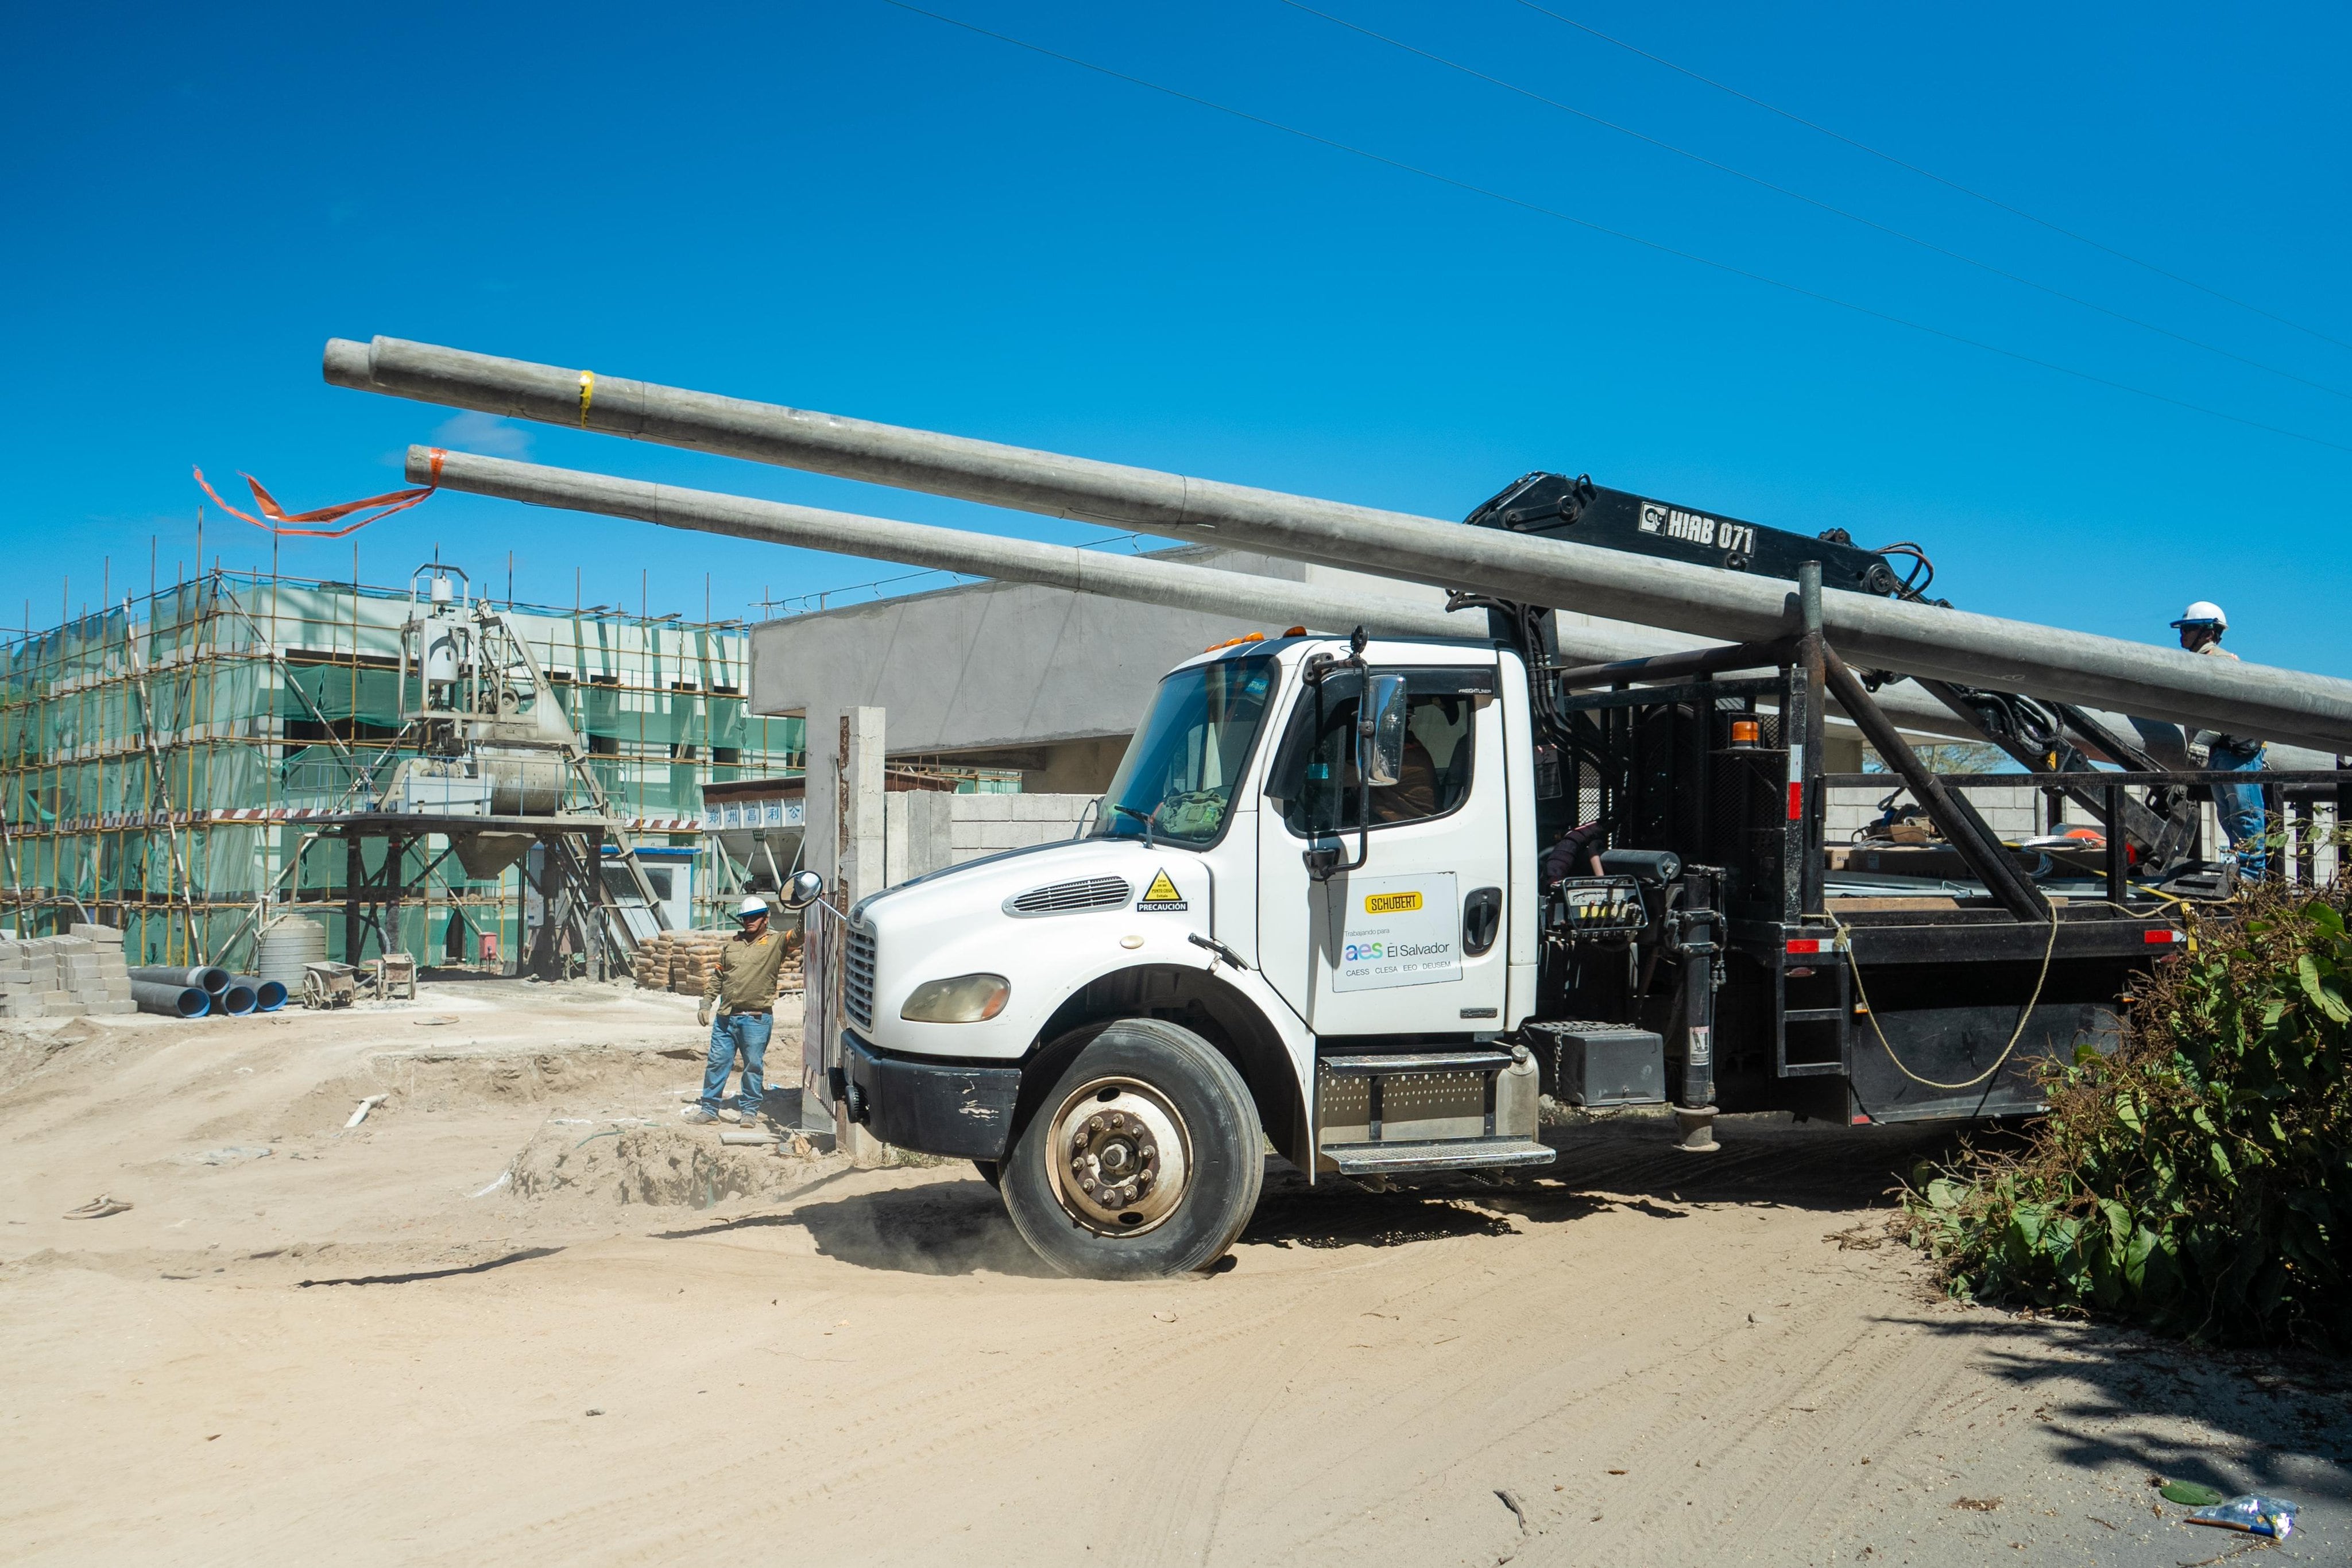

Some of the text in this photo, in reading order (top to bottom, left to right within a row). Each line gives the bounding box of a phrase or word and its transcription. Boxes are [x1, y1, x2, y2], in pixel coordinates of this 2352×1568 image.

[1667, 510, 1753, 553] HIAB 071
[1139, 903, 1186, 911] PRECAUCIÓN
[1371, 895, 1416, 911] SCHUBERT
[1345, 930, 1376, 938] Trabajando
[1345, 942, 1450, 962] aes El Salvador
[1346, 969, 1370, 977] CAESS
[1375, 966, 1398, 974] CLESA
[1422, 961, 1451, 970] DEUSEM
